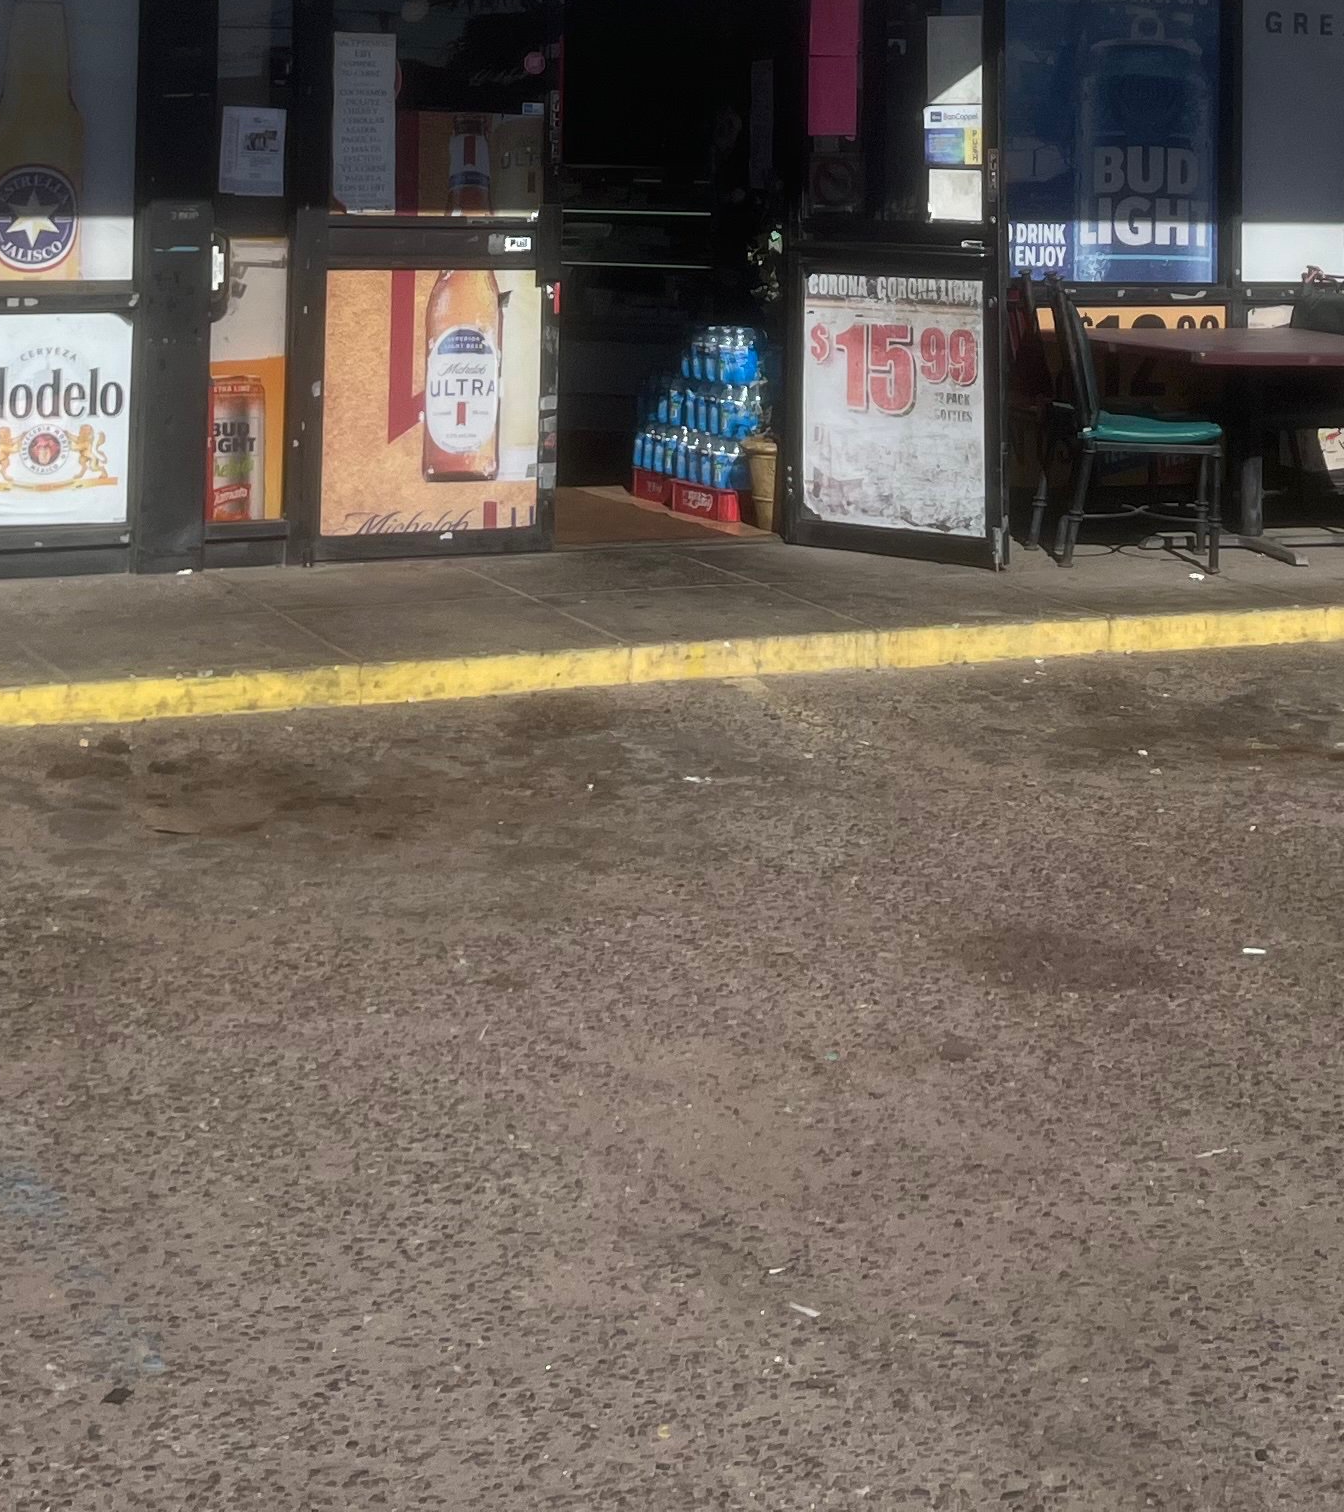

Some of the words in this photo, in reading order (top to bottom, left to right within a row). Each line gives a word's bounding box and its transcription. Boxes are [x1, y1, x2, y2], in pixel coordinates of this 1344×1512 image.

[1094, 145, 1200, 194] BUD
[1079, 196, 1207, 247] LIGHT
[1015, 223, 1066, 244] DRINK
[3, 241, 63, 261] JALISCO
[1015, 246, 1067, 267] ENJOY
[808, 273, 867, 296] CORONA
[20, 347, 77, 361] CERVEZA
[437, 362, 486, 377] Michelob
[430, 379, 495, 397] ULTRA
[946, 392, 970, 405] PACK
